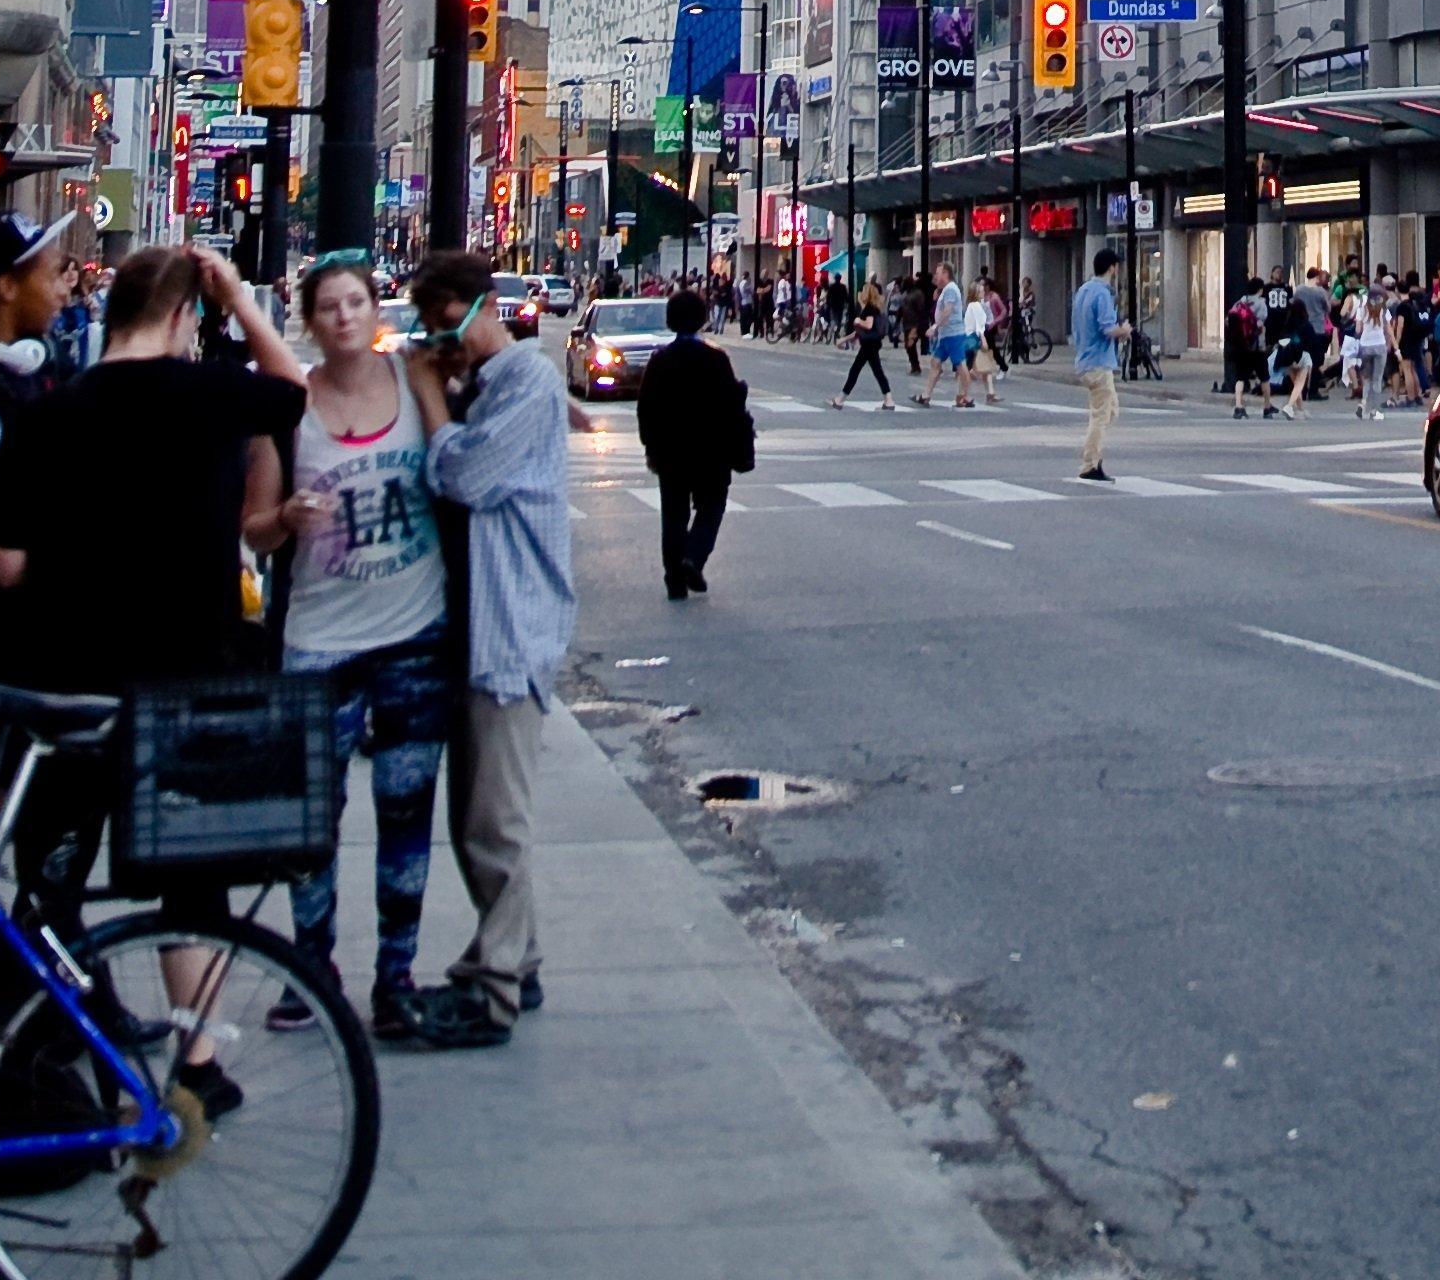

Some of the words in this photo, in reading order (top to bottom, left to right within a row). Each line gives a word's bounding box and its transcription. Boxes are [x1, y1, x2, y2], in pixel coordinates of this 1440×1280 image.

[1109, 0, 1165, 17] Dundas
[1269, 290, 1287, 307] 86
[339, 475, 416, 551] LA
